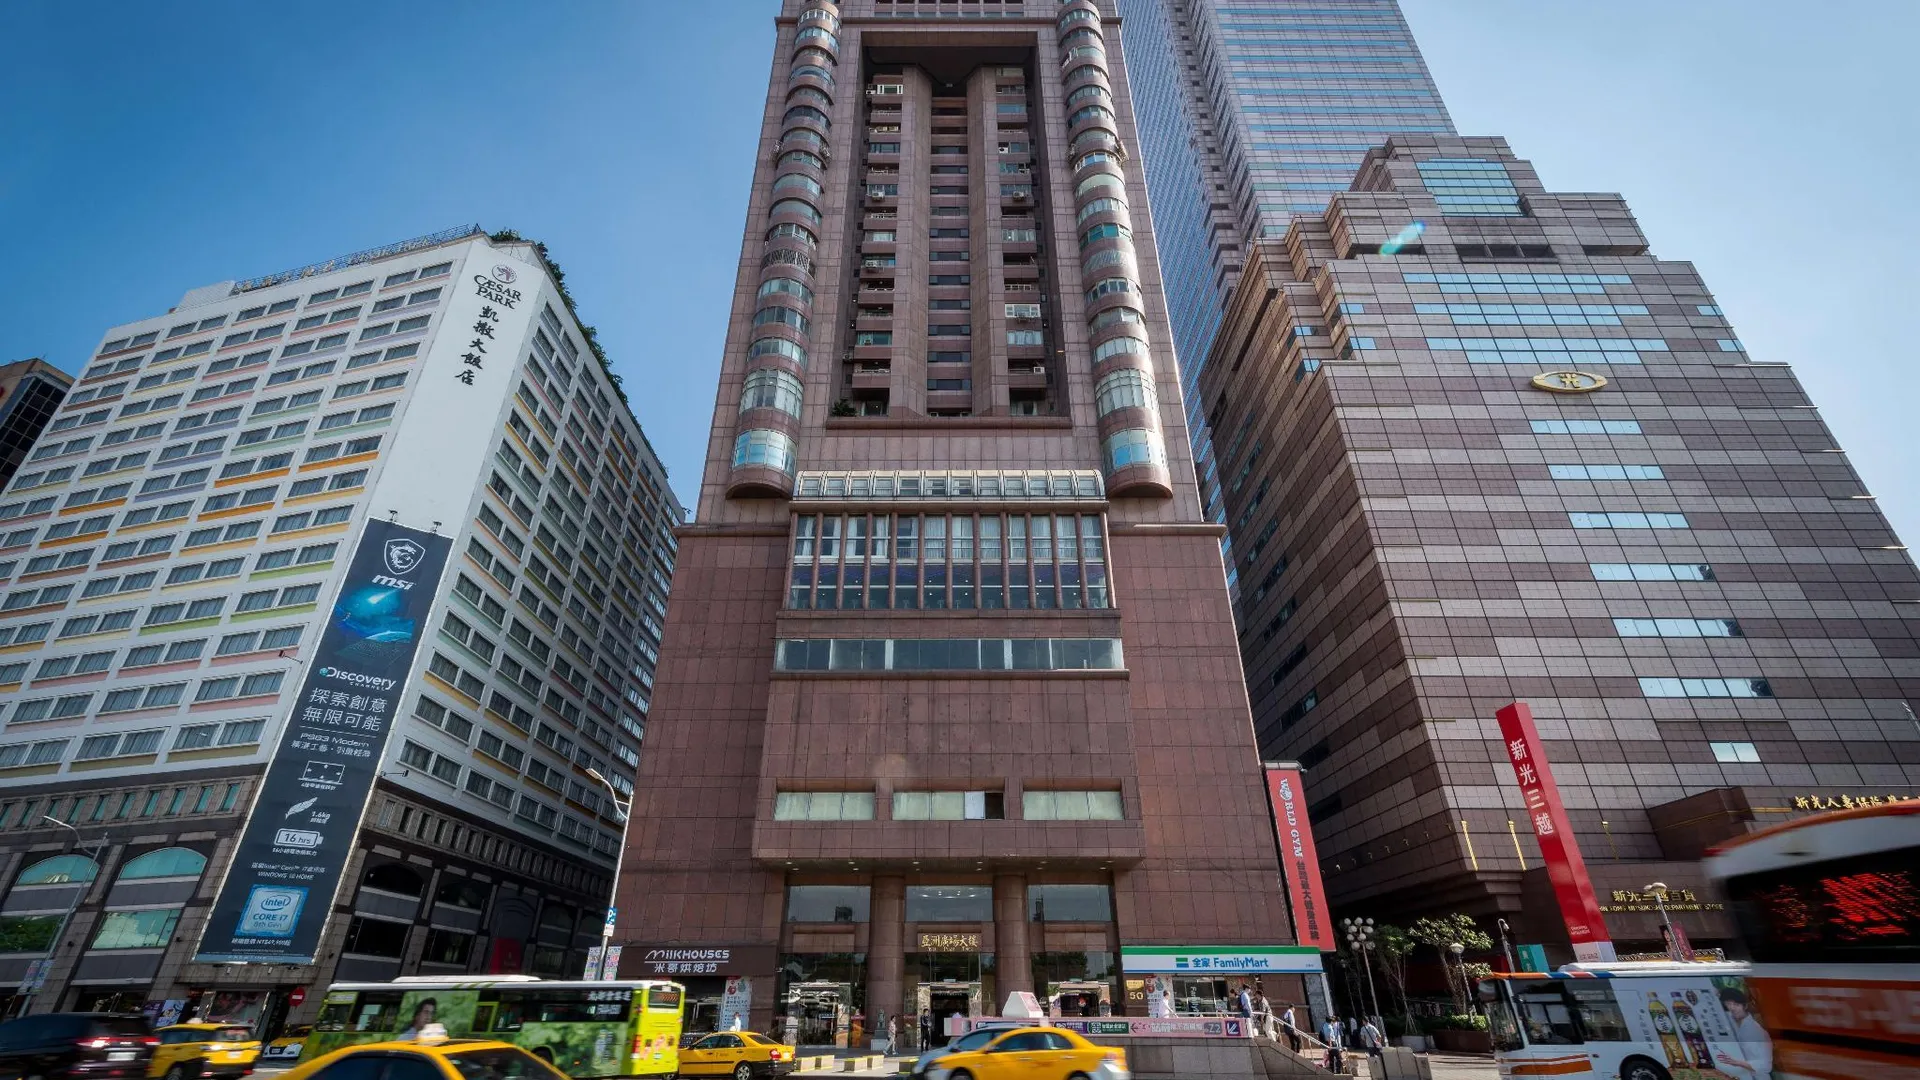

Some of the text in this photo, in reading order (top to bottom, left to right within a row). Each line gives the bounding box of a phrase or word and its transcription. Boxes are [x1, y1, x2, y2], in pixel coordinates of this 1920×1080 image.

[475, 284, 516, 310] PARK
[454, 305, 499, 386] 凱撒大飯店
[372, 575, 415, 590] msi
[321, 666, 397, 690] Discovery
[349, 681, 385, 692] CHANNEL
[308, 687, 388, 713] 探索創意
[302, 706, 382, 732] 無限可能
[331, 736, 370, 747] Modern
[1509, 738, 1554, 836] 新光三越
[284, 833, 311, 845] 16 hrs
[1290, 829, 1304, 859] GYM
[265, 897, 287, 907] intel
[253, 913, 278, 922] CORE
[654, 962, 718, 974] 米哥烘焙坊
[1192, 956, 1269, 969] 全家 FamilyMart
[1129, 991, 1144, 1000] 50
